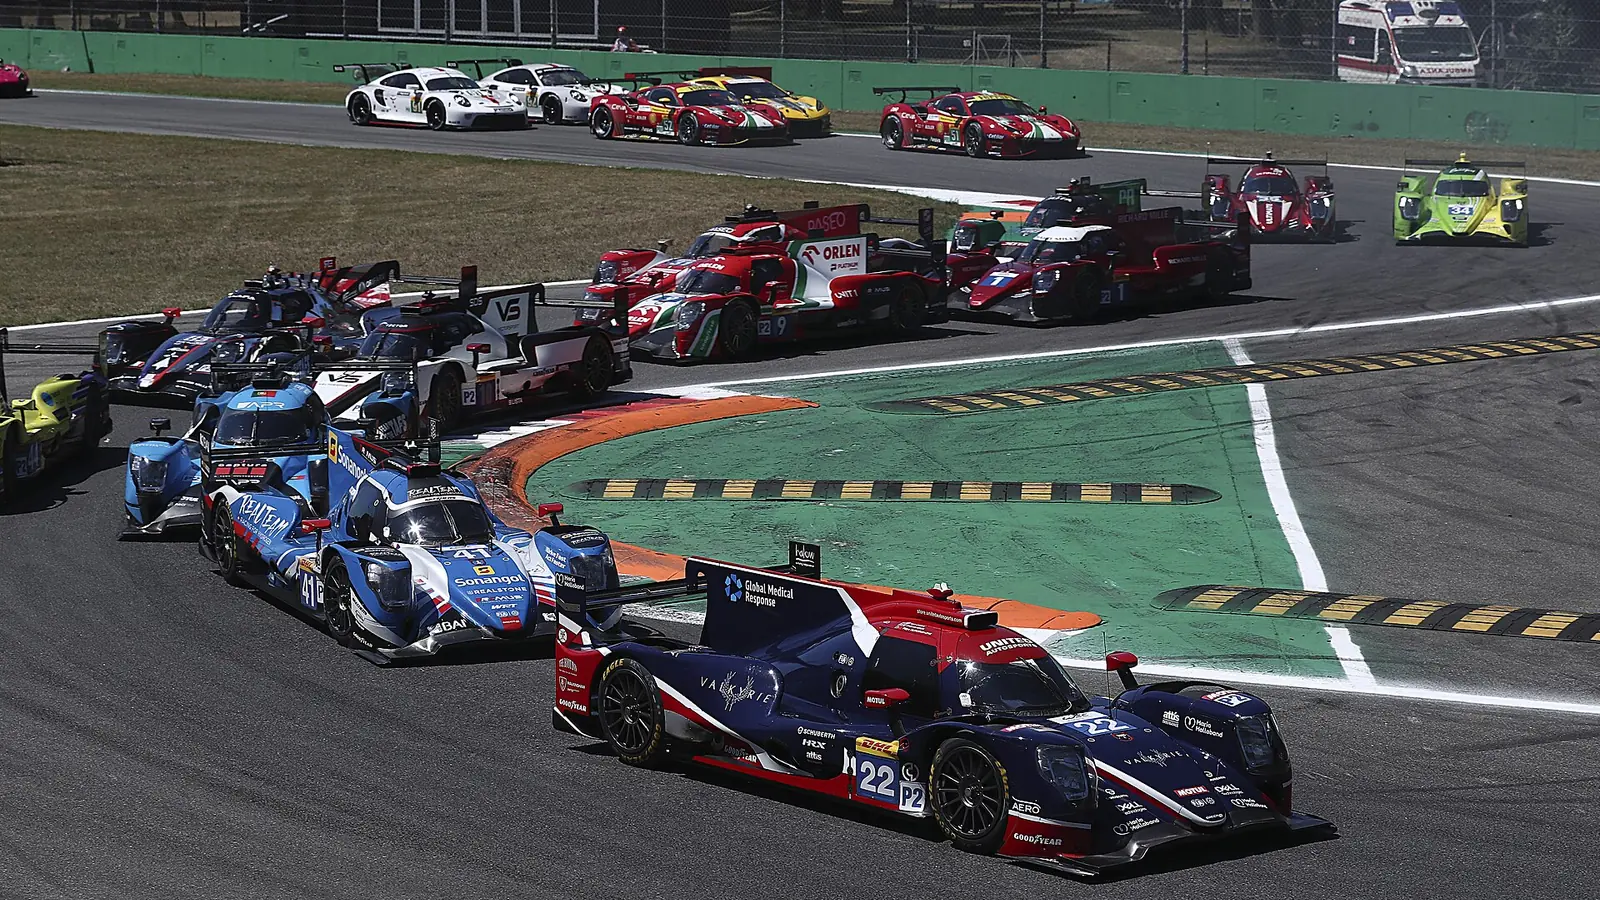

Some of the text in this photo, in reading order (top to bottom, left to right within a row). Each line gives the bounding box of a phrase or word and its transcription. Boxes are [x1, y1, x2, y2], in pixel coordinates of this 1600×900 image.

[663, 119, 672, 131] 52
[951, 128, 959, 141] 51
[1450, 206, 1471, 216] 34
[823, 244, 860, 261] ORLEN
[990, 276, 1005, 286] 1
[834, 289, 854, 299] UNIT
[1117, 283, 1124, 301] 1
[496, 297, 521, 322] VS
[759, 321, 770, 335] P2
[777, 315, 786, 336] 9
[464, 389, 476, 404] P2
[408, 485, 461, 498] REALTEAM
[239, 494, 290, 540] REALTEAM
[453, 548, 491, 560] 41
[454, 573, 526, 588] Sonangol
[302, 573, 315, 608] 41
[473, 586, 527, 595] REALSTONE
[744, 578, 794, 601] Global Medical
[744, 592, 777, 608] Response
[979, 636, 1035, 651] UNITED
[985, 643, 1039, 657] AUTOSPORTS
[602, 658, 625, 682] EAGLE
[699, 677, 773, 705] VALKYRIE
[559, 698, 588, 713] GOODYEAR
[866, 696, 886, 705] MOTUL
[1217, 693, 1248, 707] P2
[1074, 717, 1131, 736] 22
[803, 728, 837, 741] SCHUBERTH
[860, 740, 897, 755] DHL
[860, 760, 896, 797] 22
[996, 760, 1010, 800] EAGLE
[902, 785, 923, 809] P2
[1177, 786, 1209, 798] MOTUL
[1012, 801, 1041, 815] AERO
[1013, 831, 1062, 847] GOODYEAR
